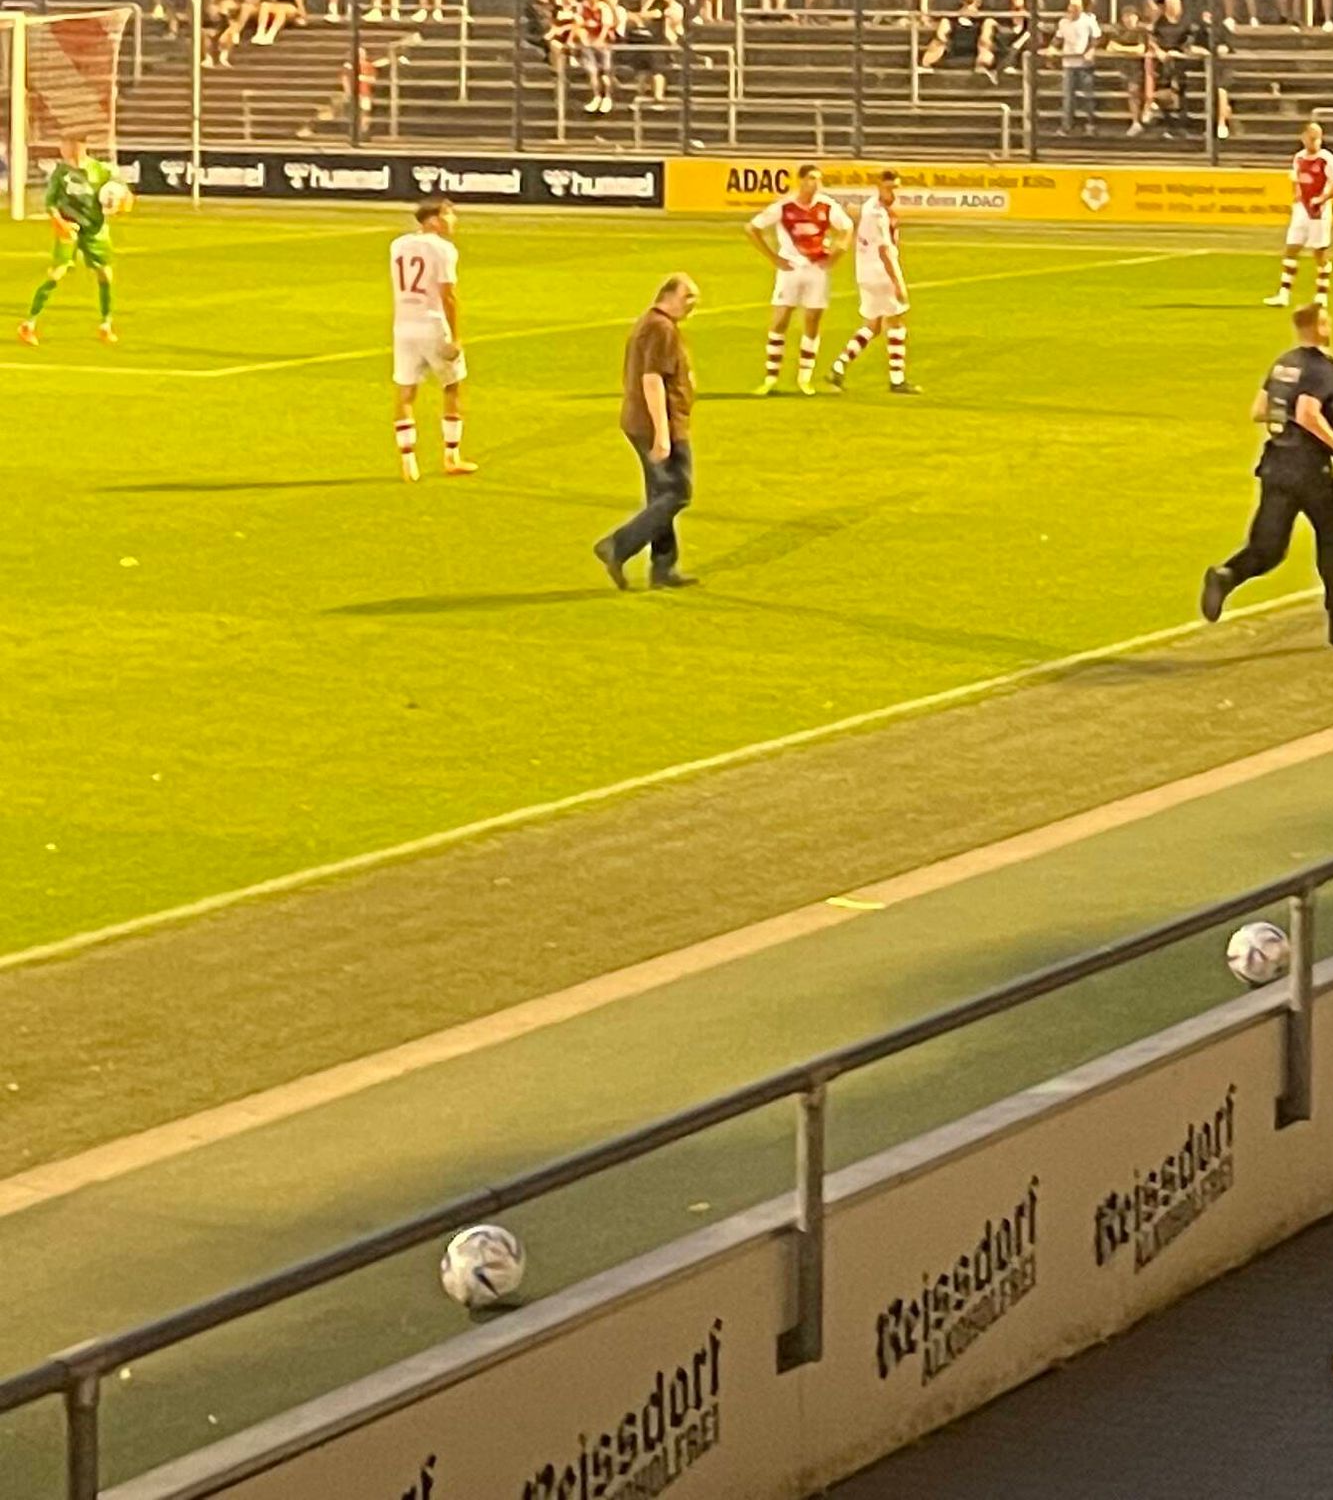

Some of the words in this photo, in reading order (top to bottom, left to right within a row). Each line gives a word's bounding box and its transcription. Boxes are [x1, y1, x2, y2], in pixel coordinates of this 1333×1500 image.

[727, 168, 790, 194] ADAC
[395, 255, 427, 295] 12
[1095, 1083, 1237, 1267] Reissdorf
[875, 1174, 1039, 1380] Reissdorf
